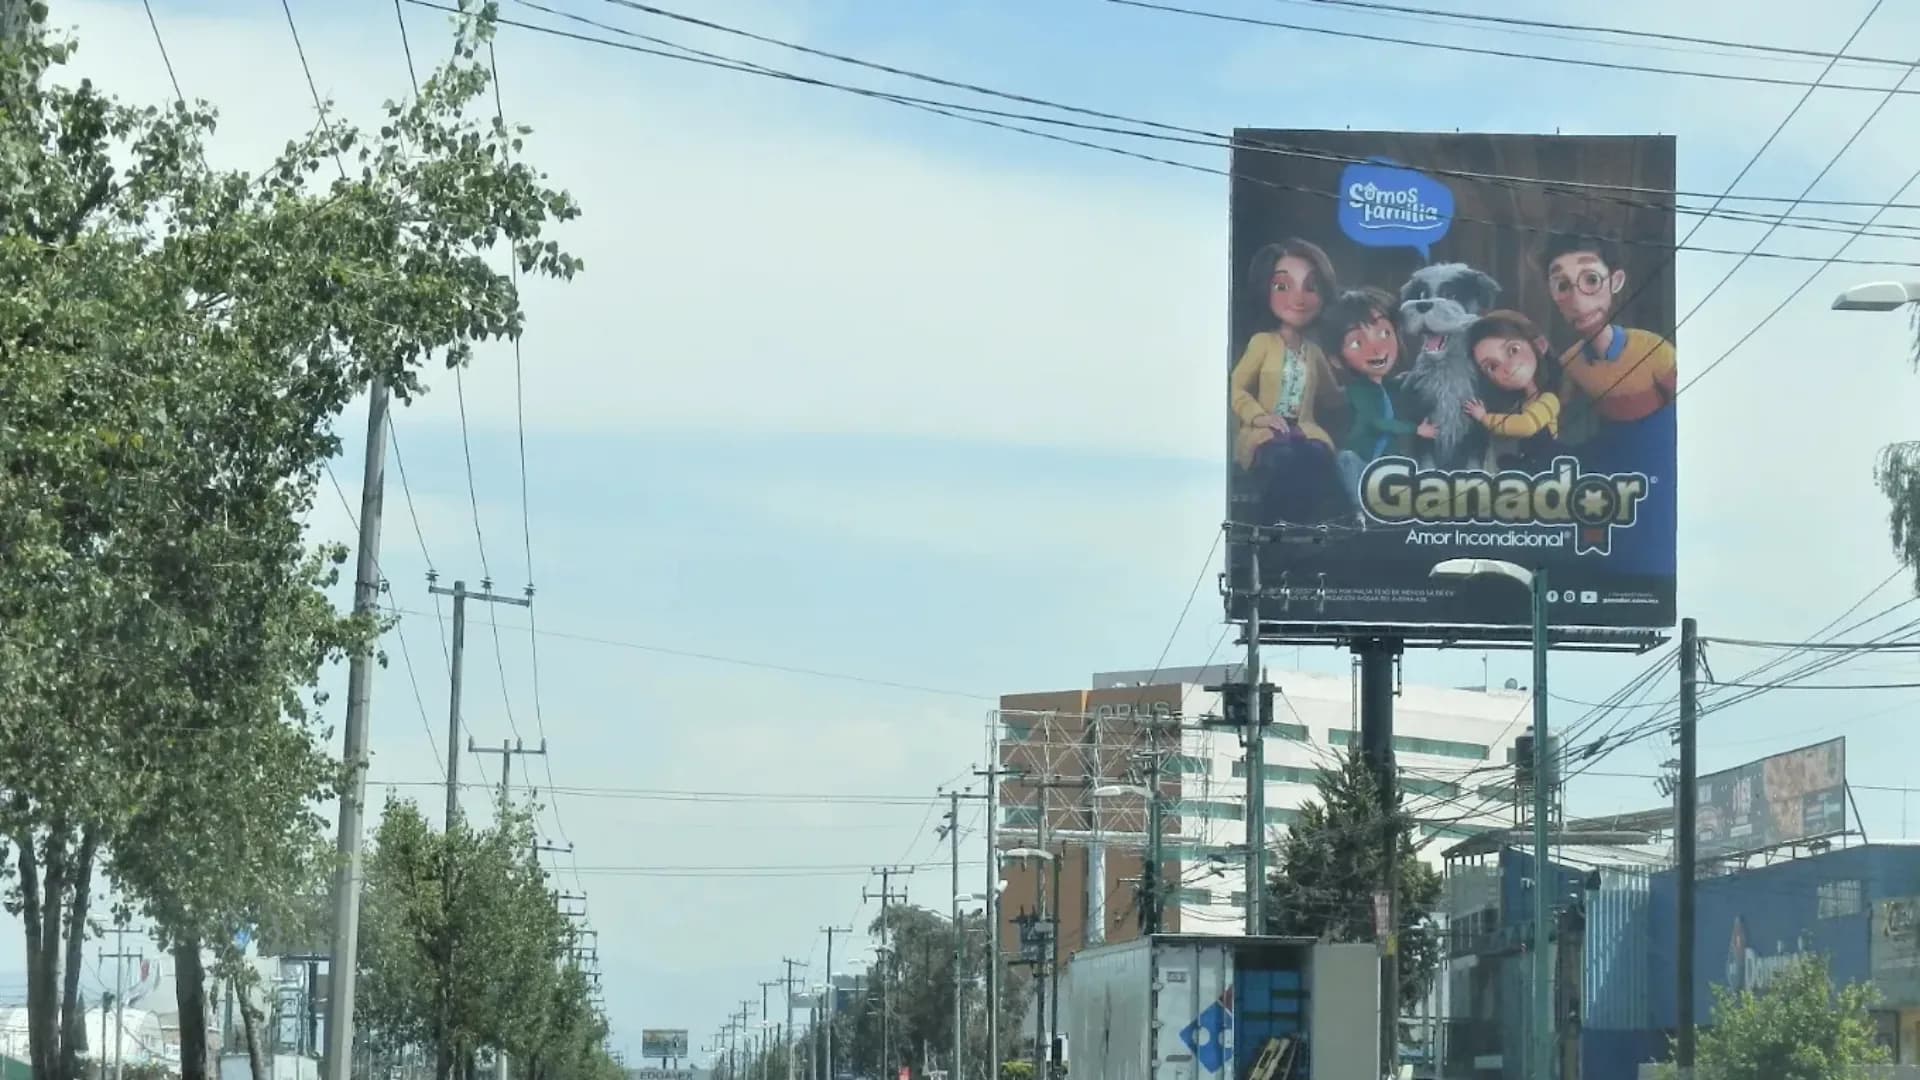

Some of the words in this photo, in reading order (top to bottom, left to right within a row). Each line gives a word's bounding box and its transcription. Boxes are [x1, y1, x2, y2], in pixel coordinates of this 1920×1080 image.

[1349, 182, 1418, 207] Somos
[1365, 462, 1641, 520] Ganador
[1405, 529, 1451, 545] Amor
